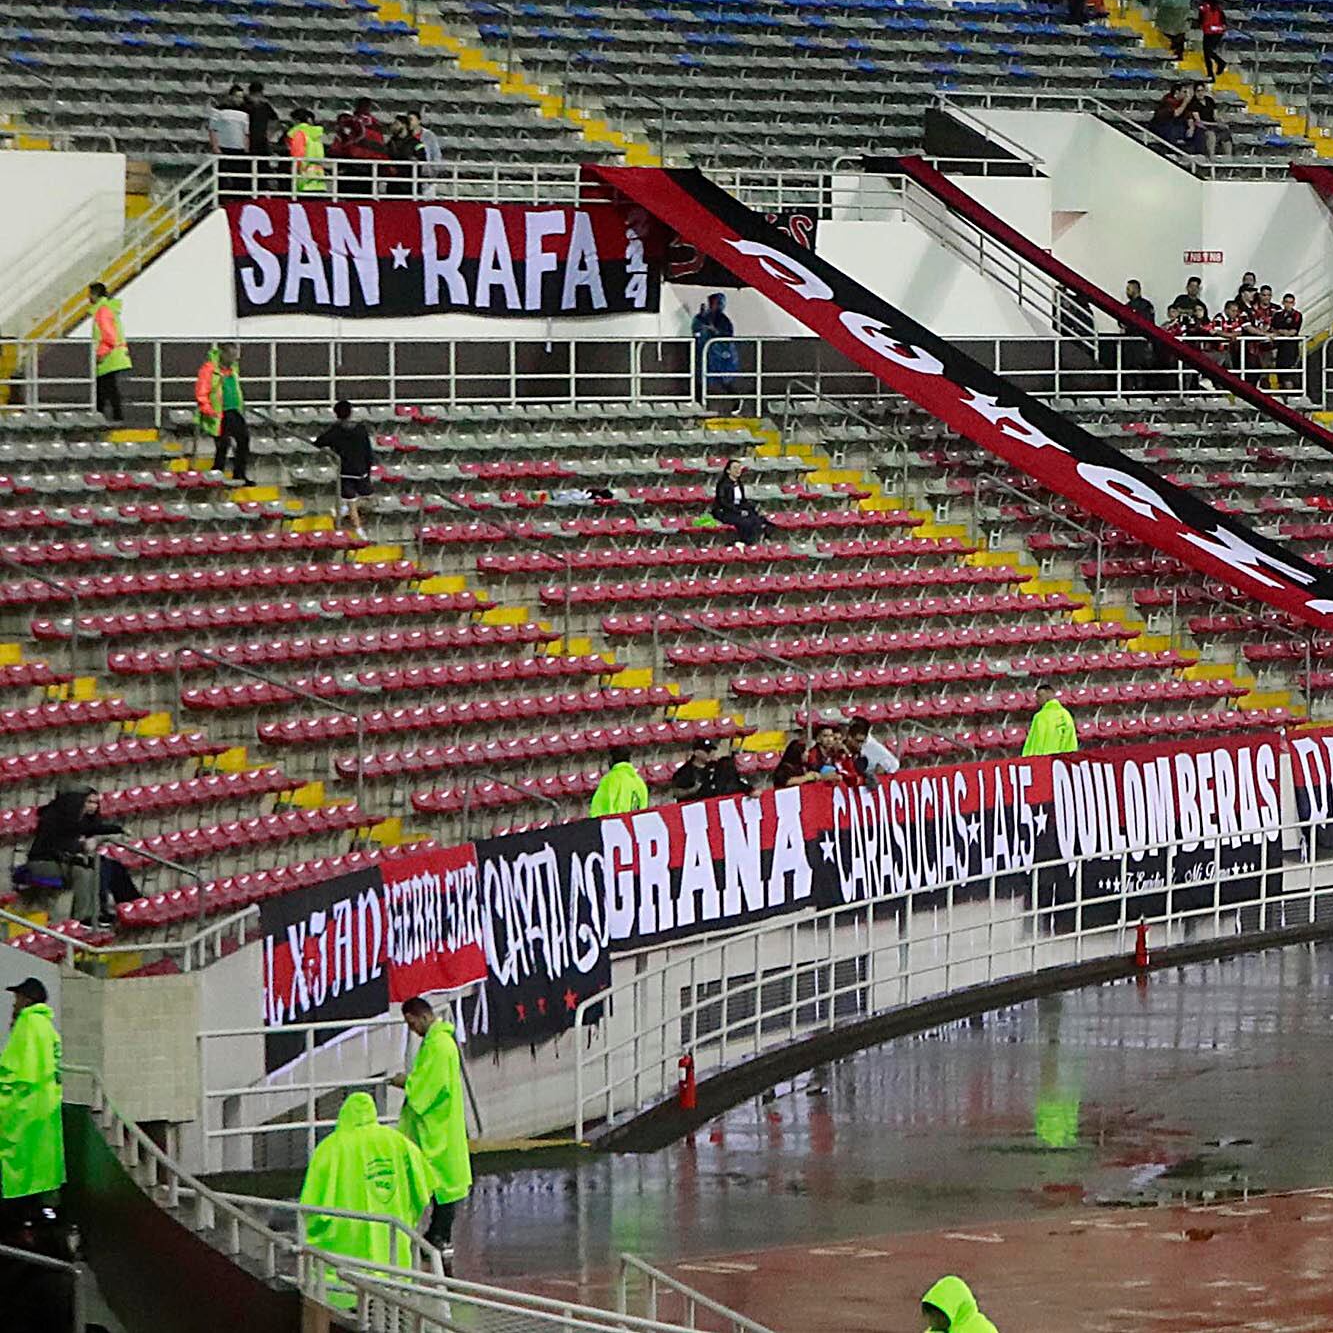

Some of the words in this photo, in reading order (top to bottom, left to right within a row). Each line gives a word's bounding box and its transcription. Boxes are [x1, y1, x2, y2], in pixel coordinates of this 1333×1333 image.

[239, 203, 379, 307] SAN
[420, 206, 606, 311] RAFA
[601, 786, 813, 939] GRANA
[1052, 744, 1279, 872] QUILOMBERAS
